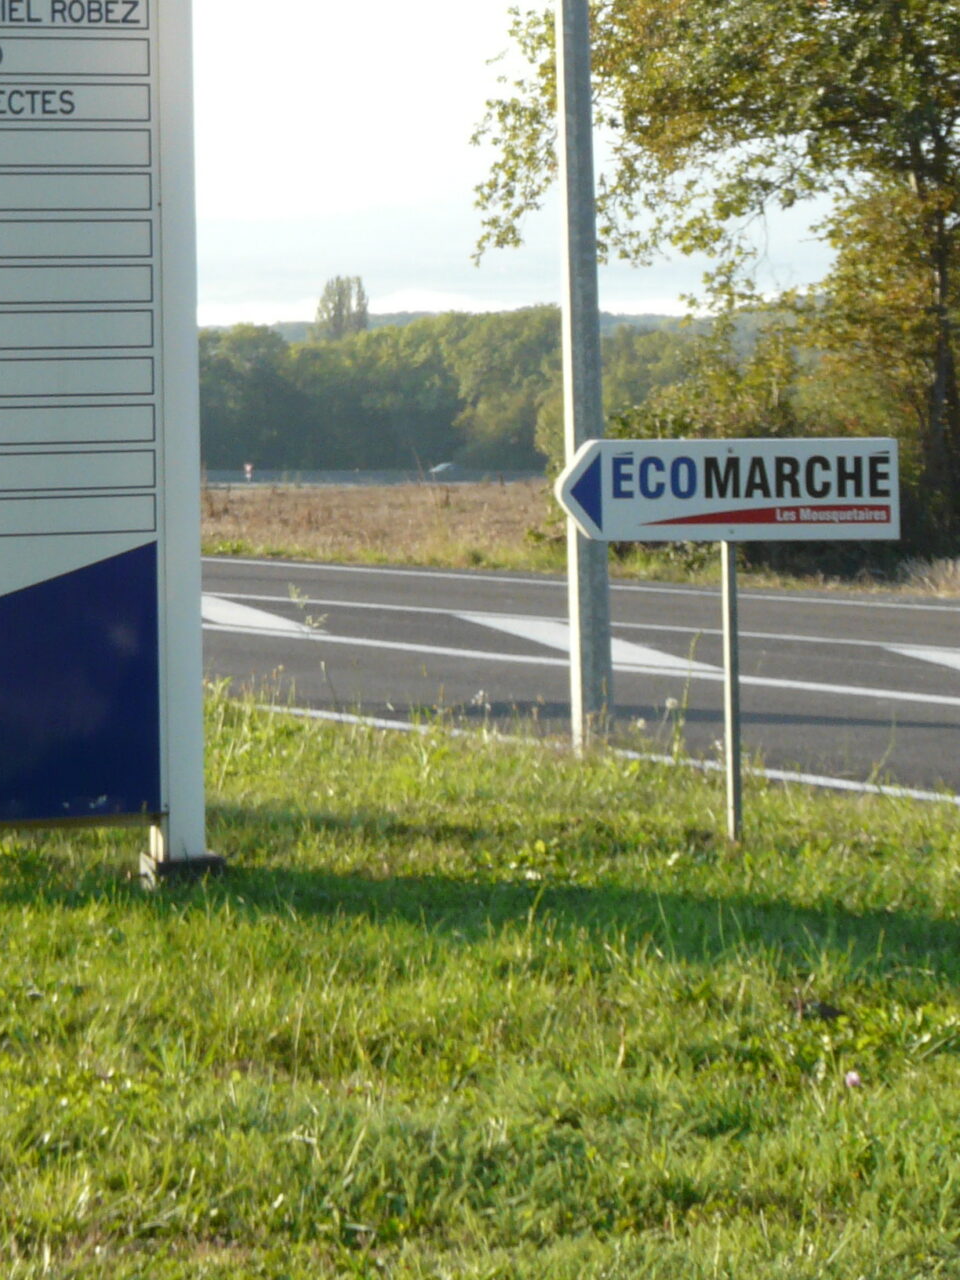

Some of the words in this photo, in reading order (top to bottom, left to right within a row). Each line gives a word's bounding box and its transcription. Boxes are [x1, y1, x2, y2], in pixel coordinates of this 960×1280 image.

[50, 0, 140, 24] ROBEZ
[776, 508, 797, 521] Les
[799, 508, 887, 522] Mousquetaires
